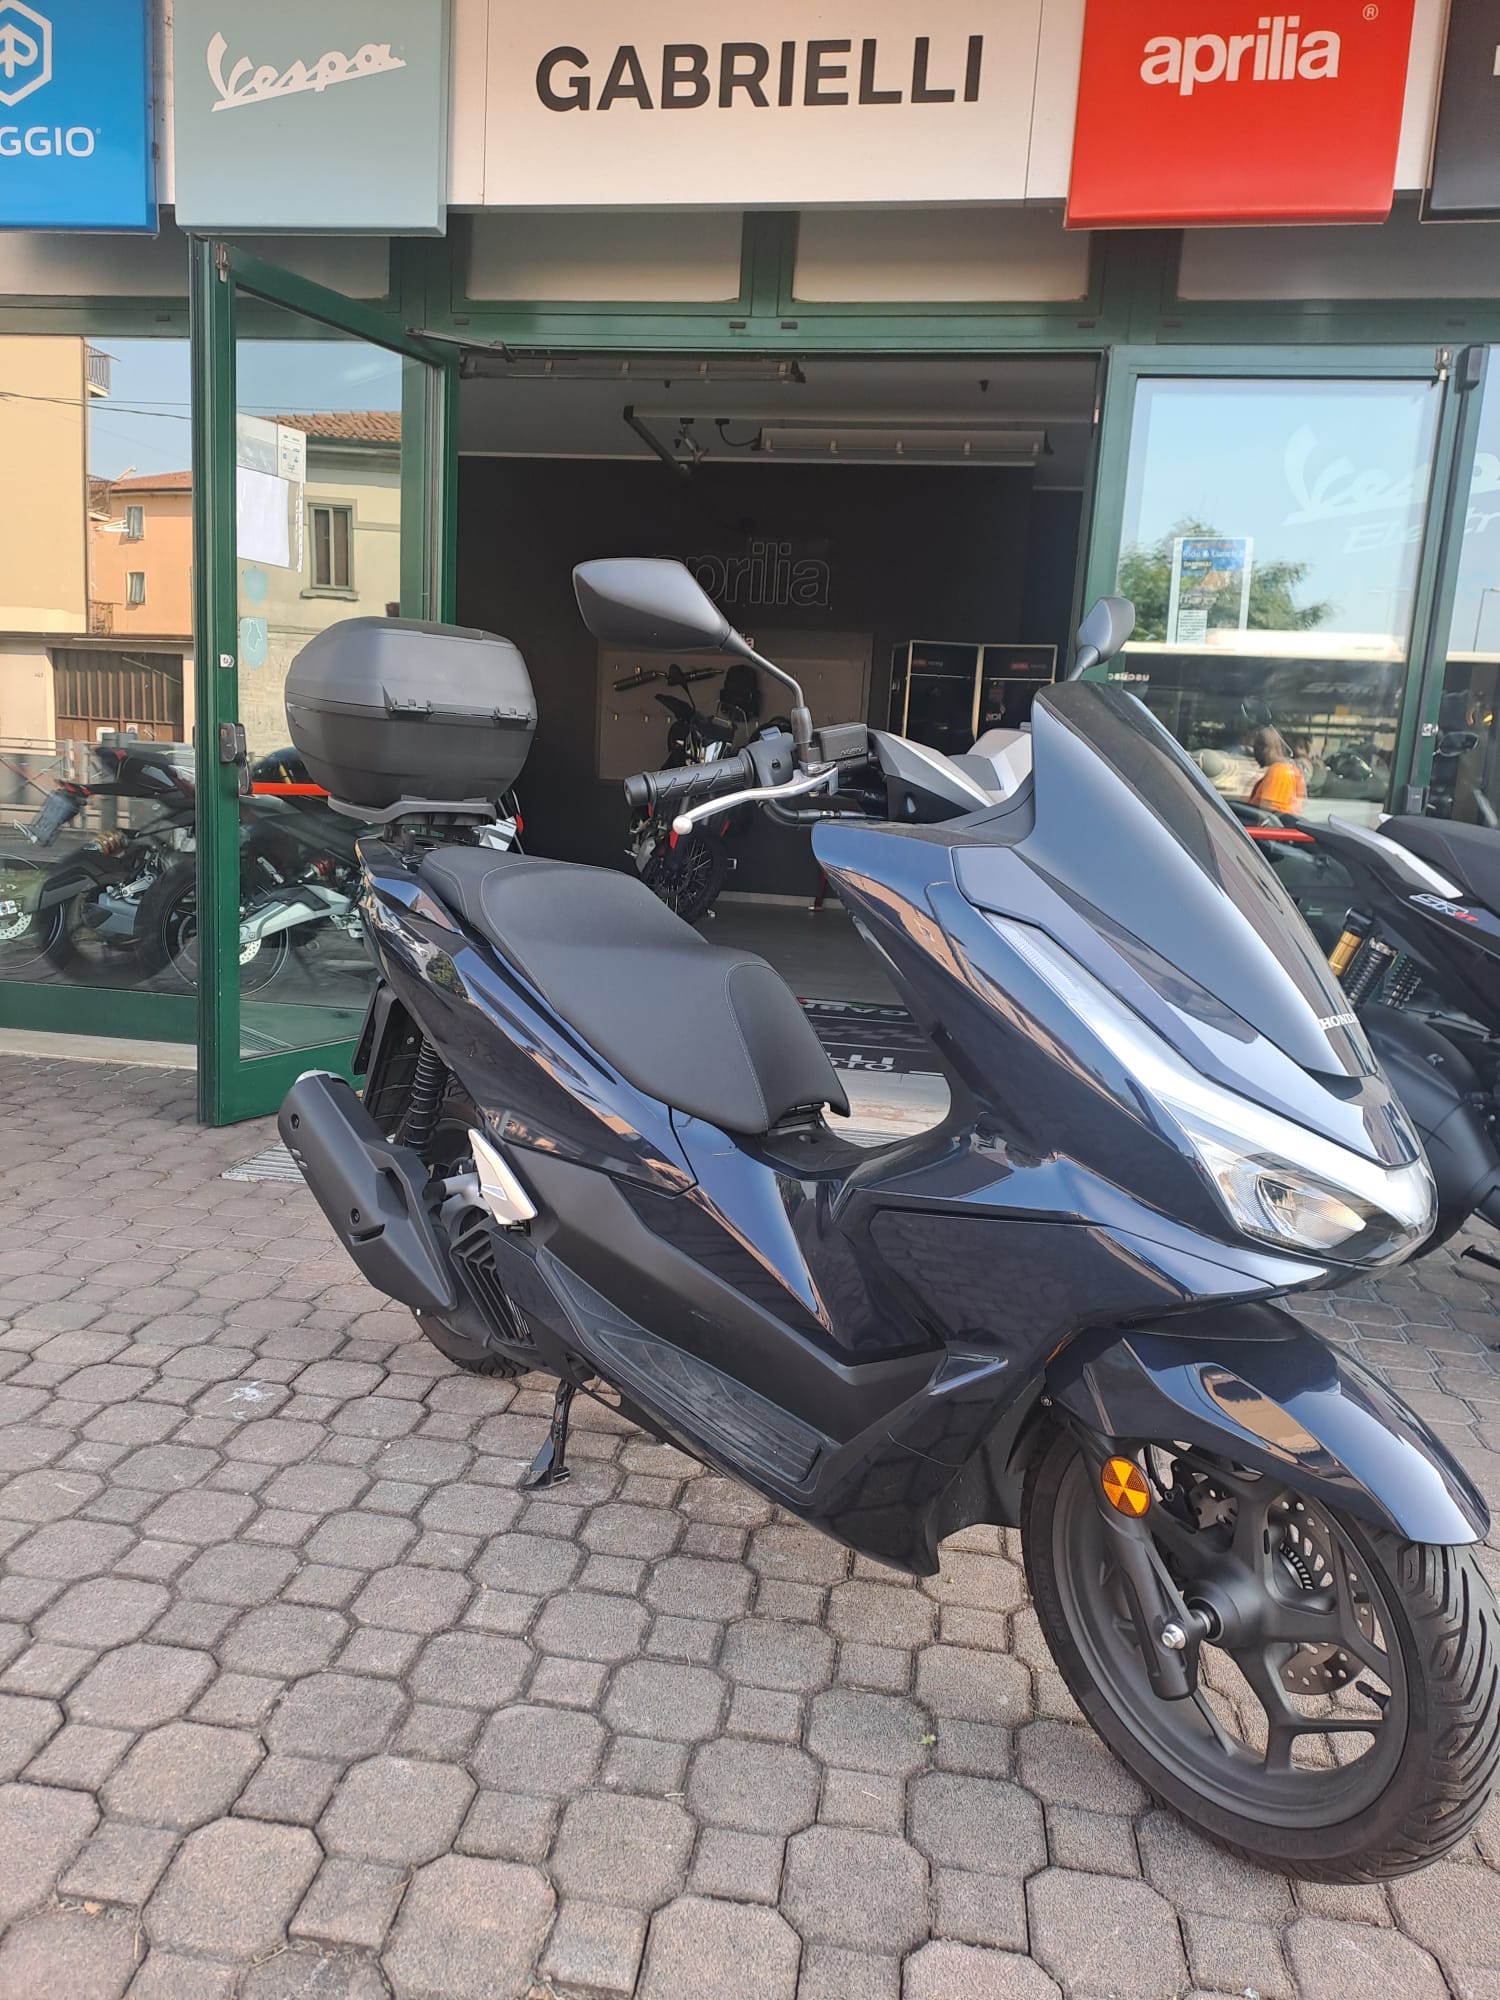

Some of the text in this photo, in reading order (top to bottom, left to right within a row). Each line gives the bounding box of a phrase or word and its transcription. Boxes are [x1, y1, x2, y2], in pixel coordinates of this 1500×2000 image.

[207, 32, 407, 112] Vespa
[535, 35, 983, 112] GABRIELLI
[1140, 15, 1341, 96] aprilia
[653, 542, 831, 606] prilia
